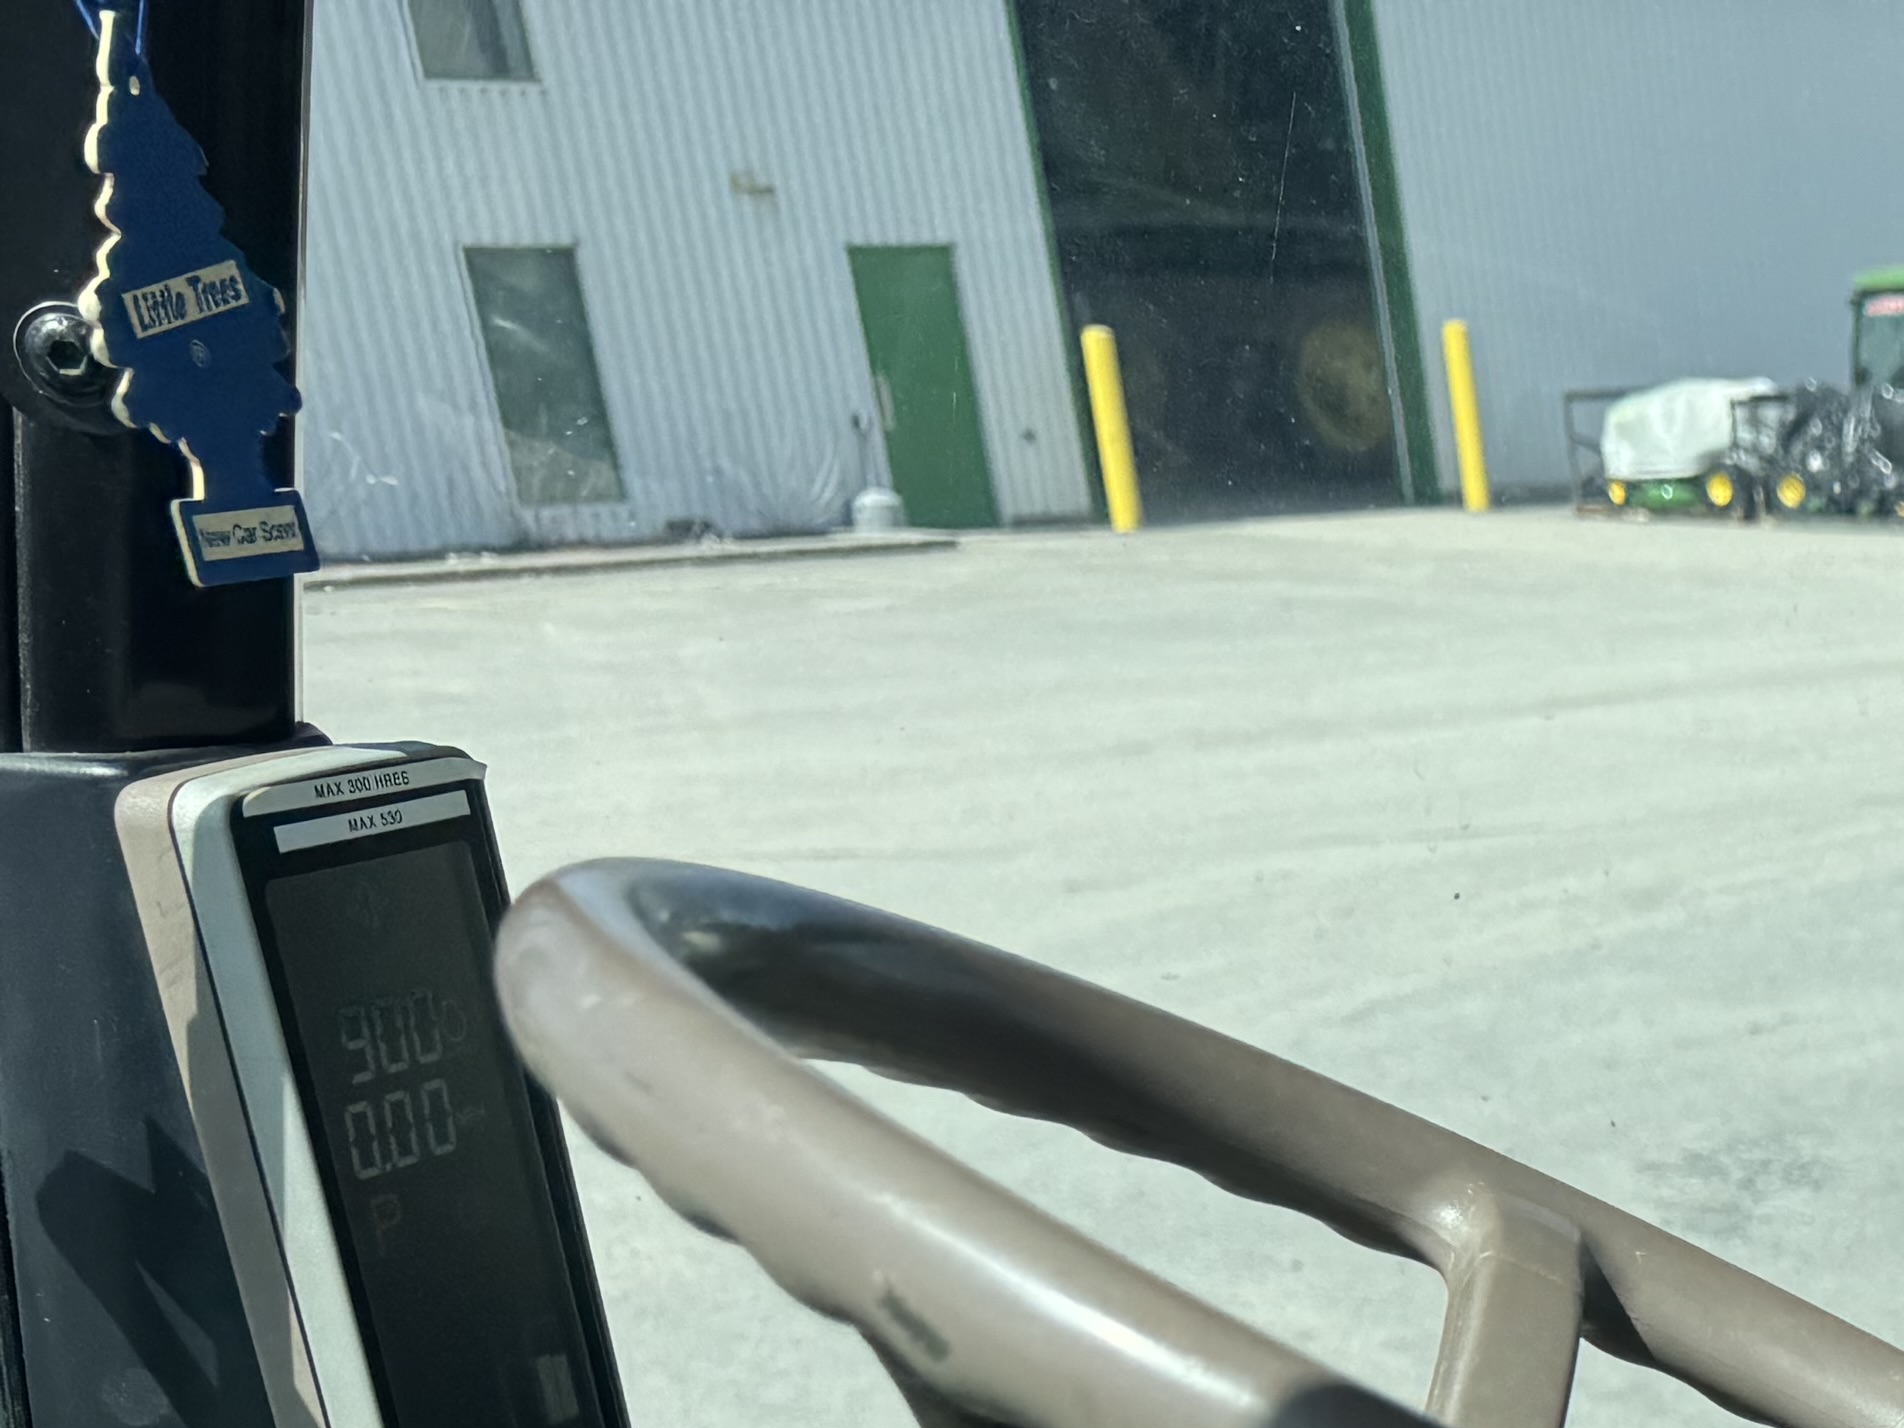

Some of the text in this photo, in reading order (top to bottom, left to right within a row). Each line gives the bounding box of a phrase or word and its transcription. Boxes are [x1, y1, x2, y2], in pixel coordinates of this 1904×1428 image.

[132, 273, 242, 332] Little Trees
[231, 523, 257, 544] Car
[314, 780, 345, 799] MAX
[347, 776, 371, 795] 300
[347, 815, 376, 833] MAX
